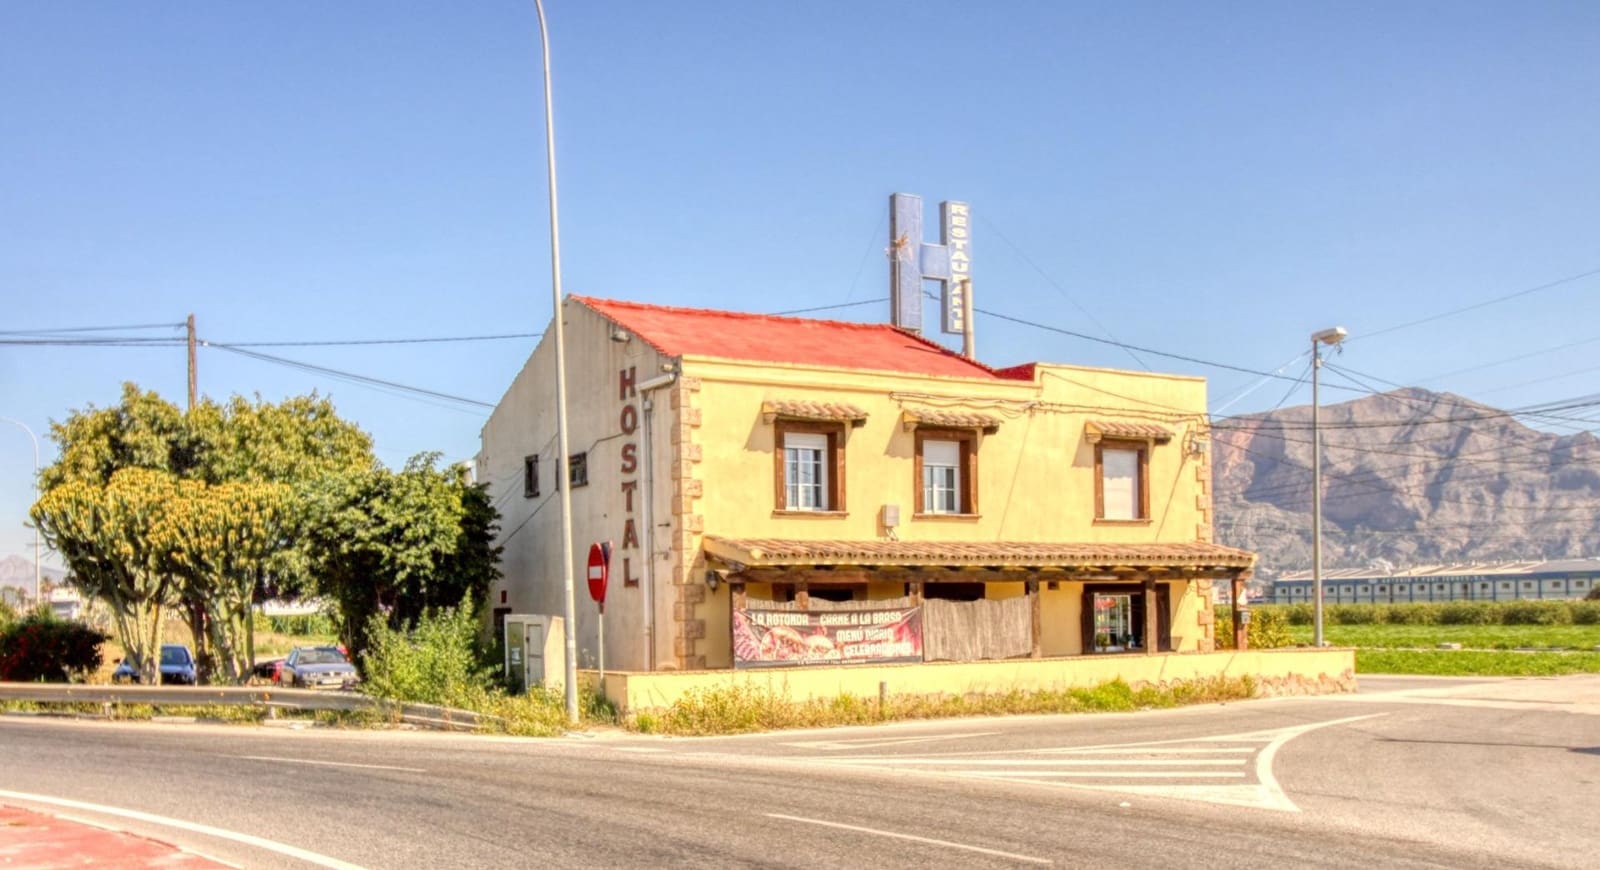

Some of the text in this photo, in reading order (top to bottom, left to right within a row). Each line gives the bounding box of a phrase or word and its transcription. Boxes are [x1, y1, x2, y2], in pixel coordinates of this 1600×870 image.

[619, 366, 639, 589] HOSTAL
[766, 613, 808, 626] ROTONDA
[819, 610, 904, 625] CARNE A LA BRASA
